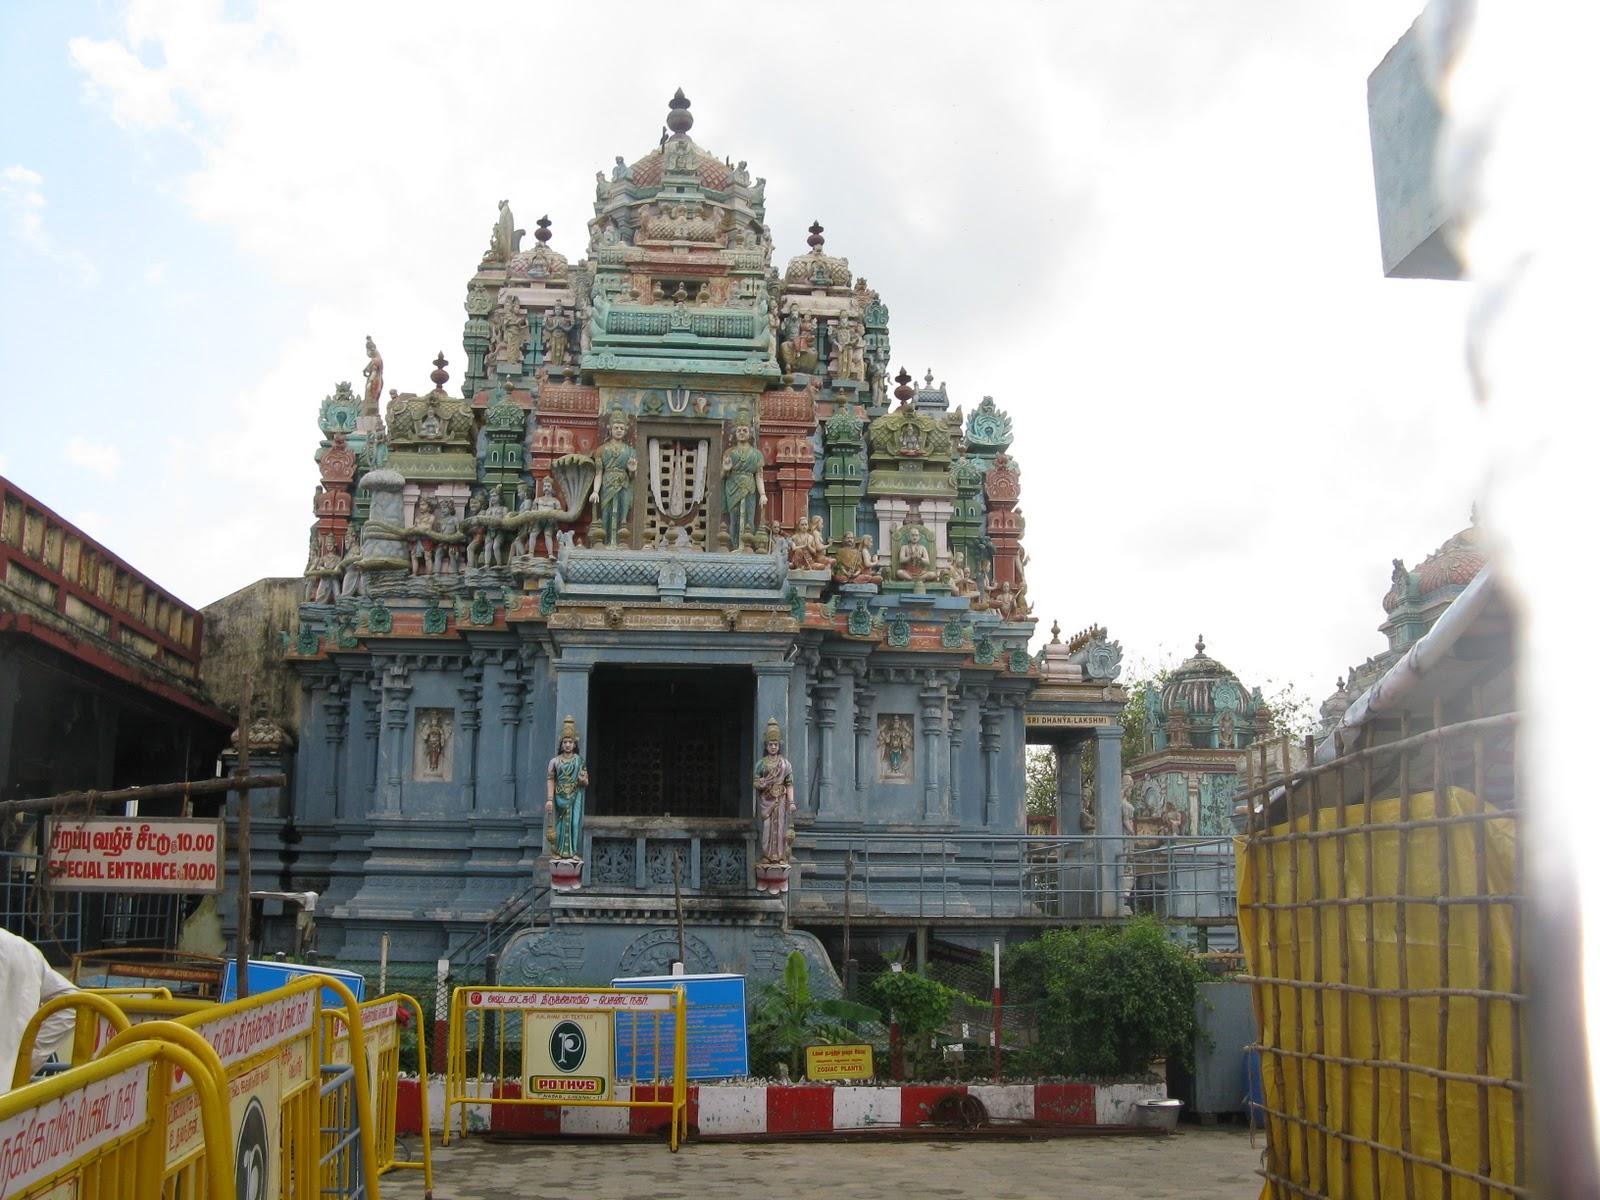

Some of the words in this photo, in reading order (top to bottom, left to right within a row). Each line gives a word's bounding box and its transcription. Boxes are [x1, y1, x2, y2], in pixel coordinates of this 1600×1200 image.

[93, 825, 133, 857] வழிச்
[136, 824, 171, 857] சீட்டு
[177, 833, 215, 852] 10.00
[48, 860, 105, 879] SPECIAL
[107, 861, 177, 880] ENTRANCE
[183, 862, 216, 881] 10.00
[538, 1079, 595, 1090] POTHYS
